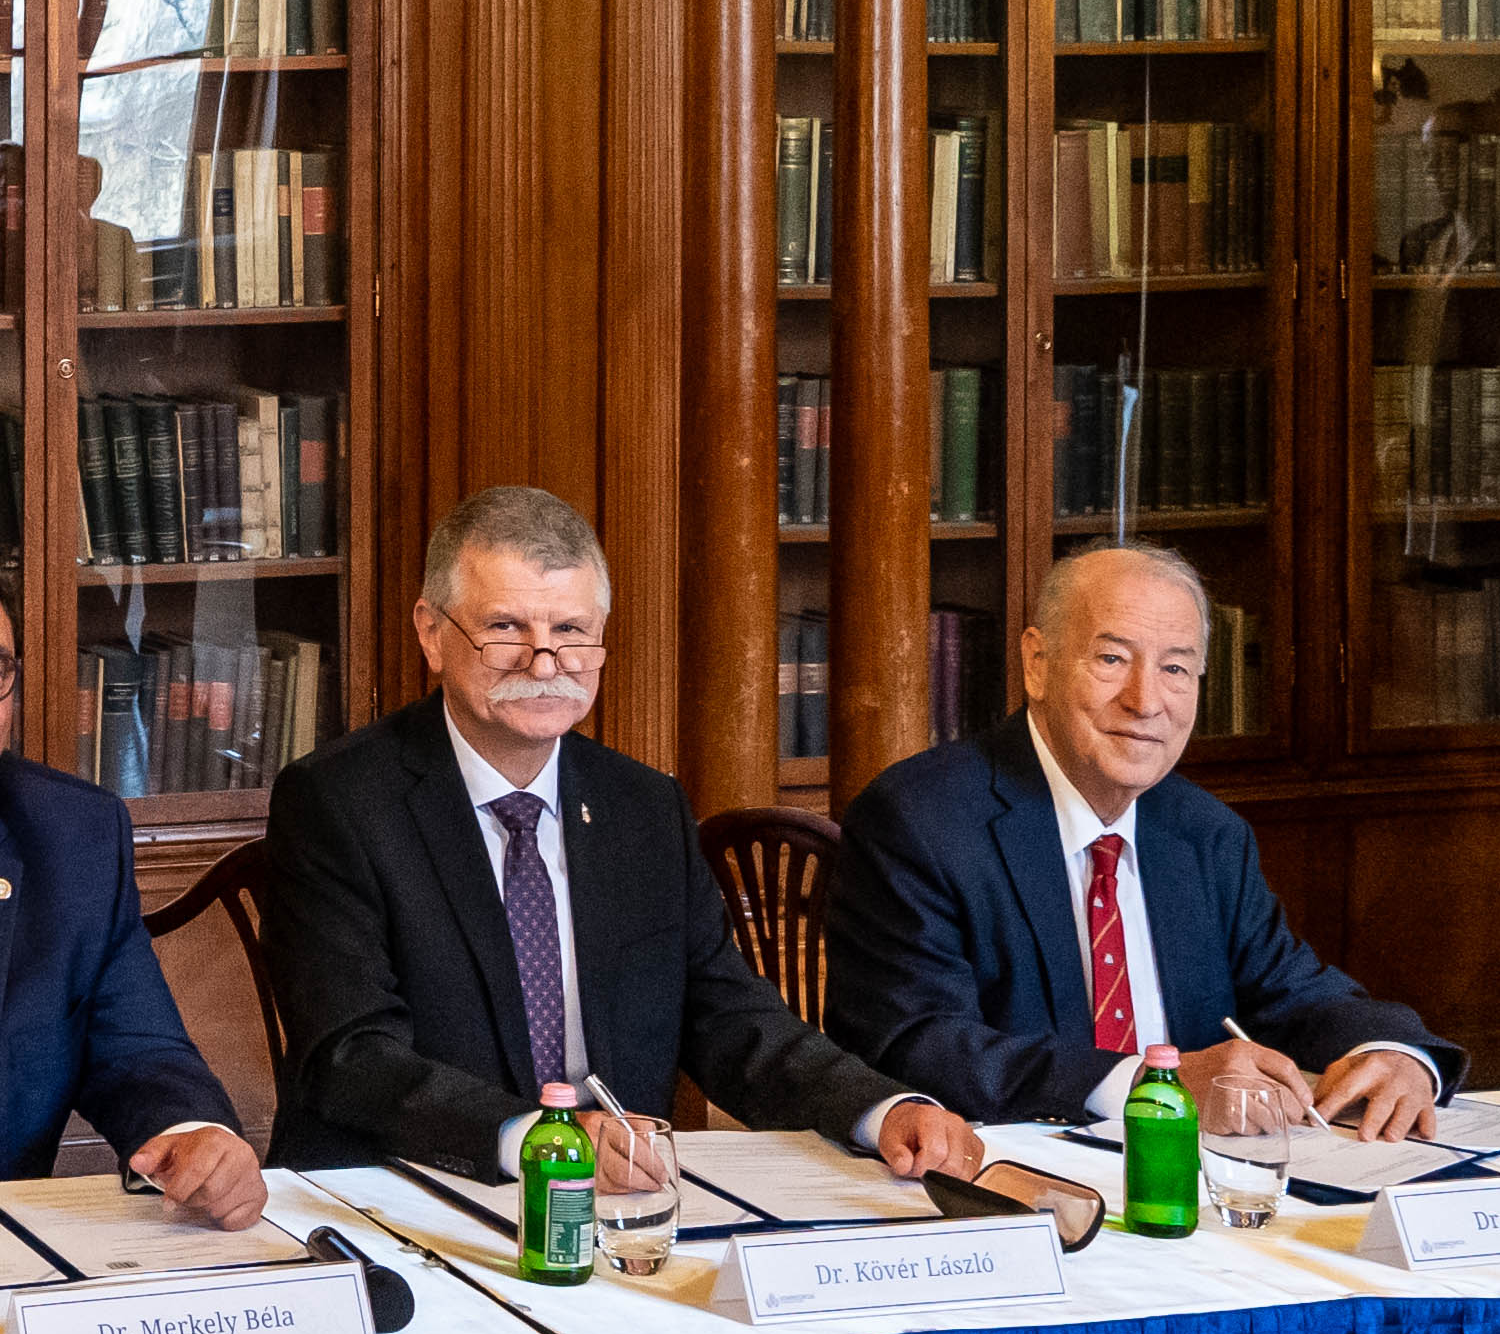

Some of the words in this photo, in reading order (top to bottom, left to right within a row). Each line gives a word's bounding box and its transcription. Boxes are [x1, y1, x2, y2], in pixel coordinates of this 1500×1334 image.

[814, 1263, 850, 1286] Dr.
[856, 1257, 920, 1282] Kövér
[928, 1252, 994, 1277] László
[245, 1305, 295, 1333] Béla
